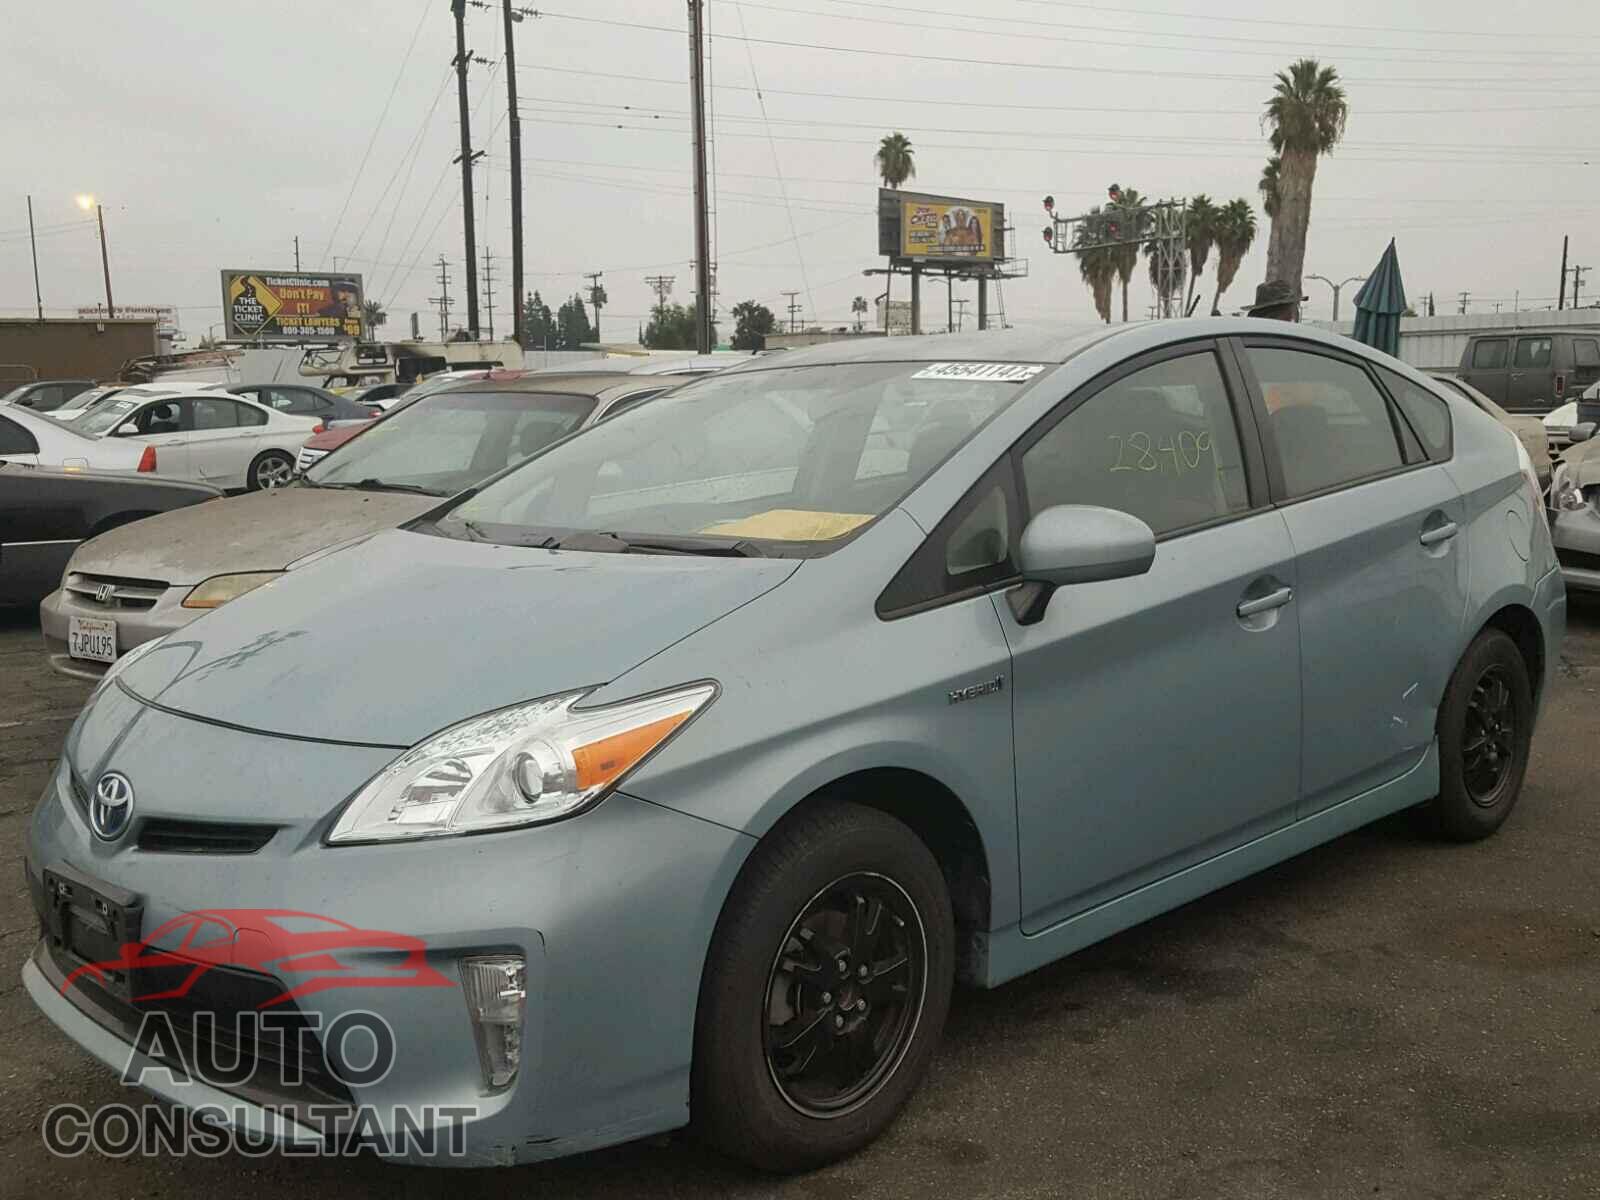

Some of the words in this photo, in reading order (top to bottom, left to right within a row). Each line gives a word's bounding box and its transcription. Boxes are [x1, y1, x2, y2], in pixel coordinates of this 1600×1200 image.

[279, 289, 305, 299] Don't
[307, 290, 325, 301] Pay
[239, 297, 257, 305] THE
[234, 305, 263, 314] TICKET
[234, 313, 265, 322] CLINIC
[72, 632, 113, 656] 7JPU195
